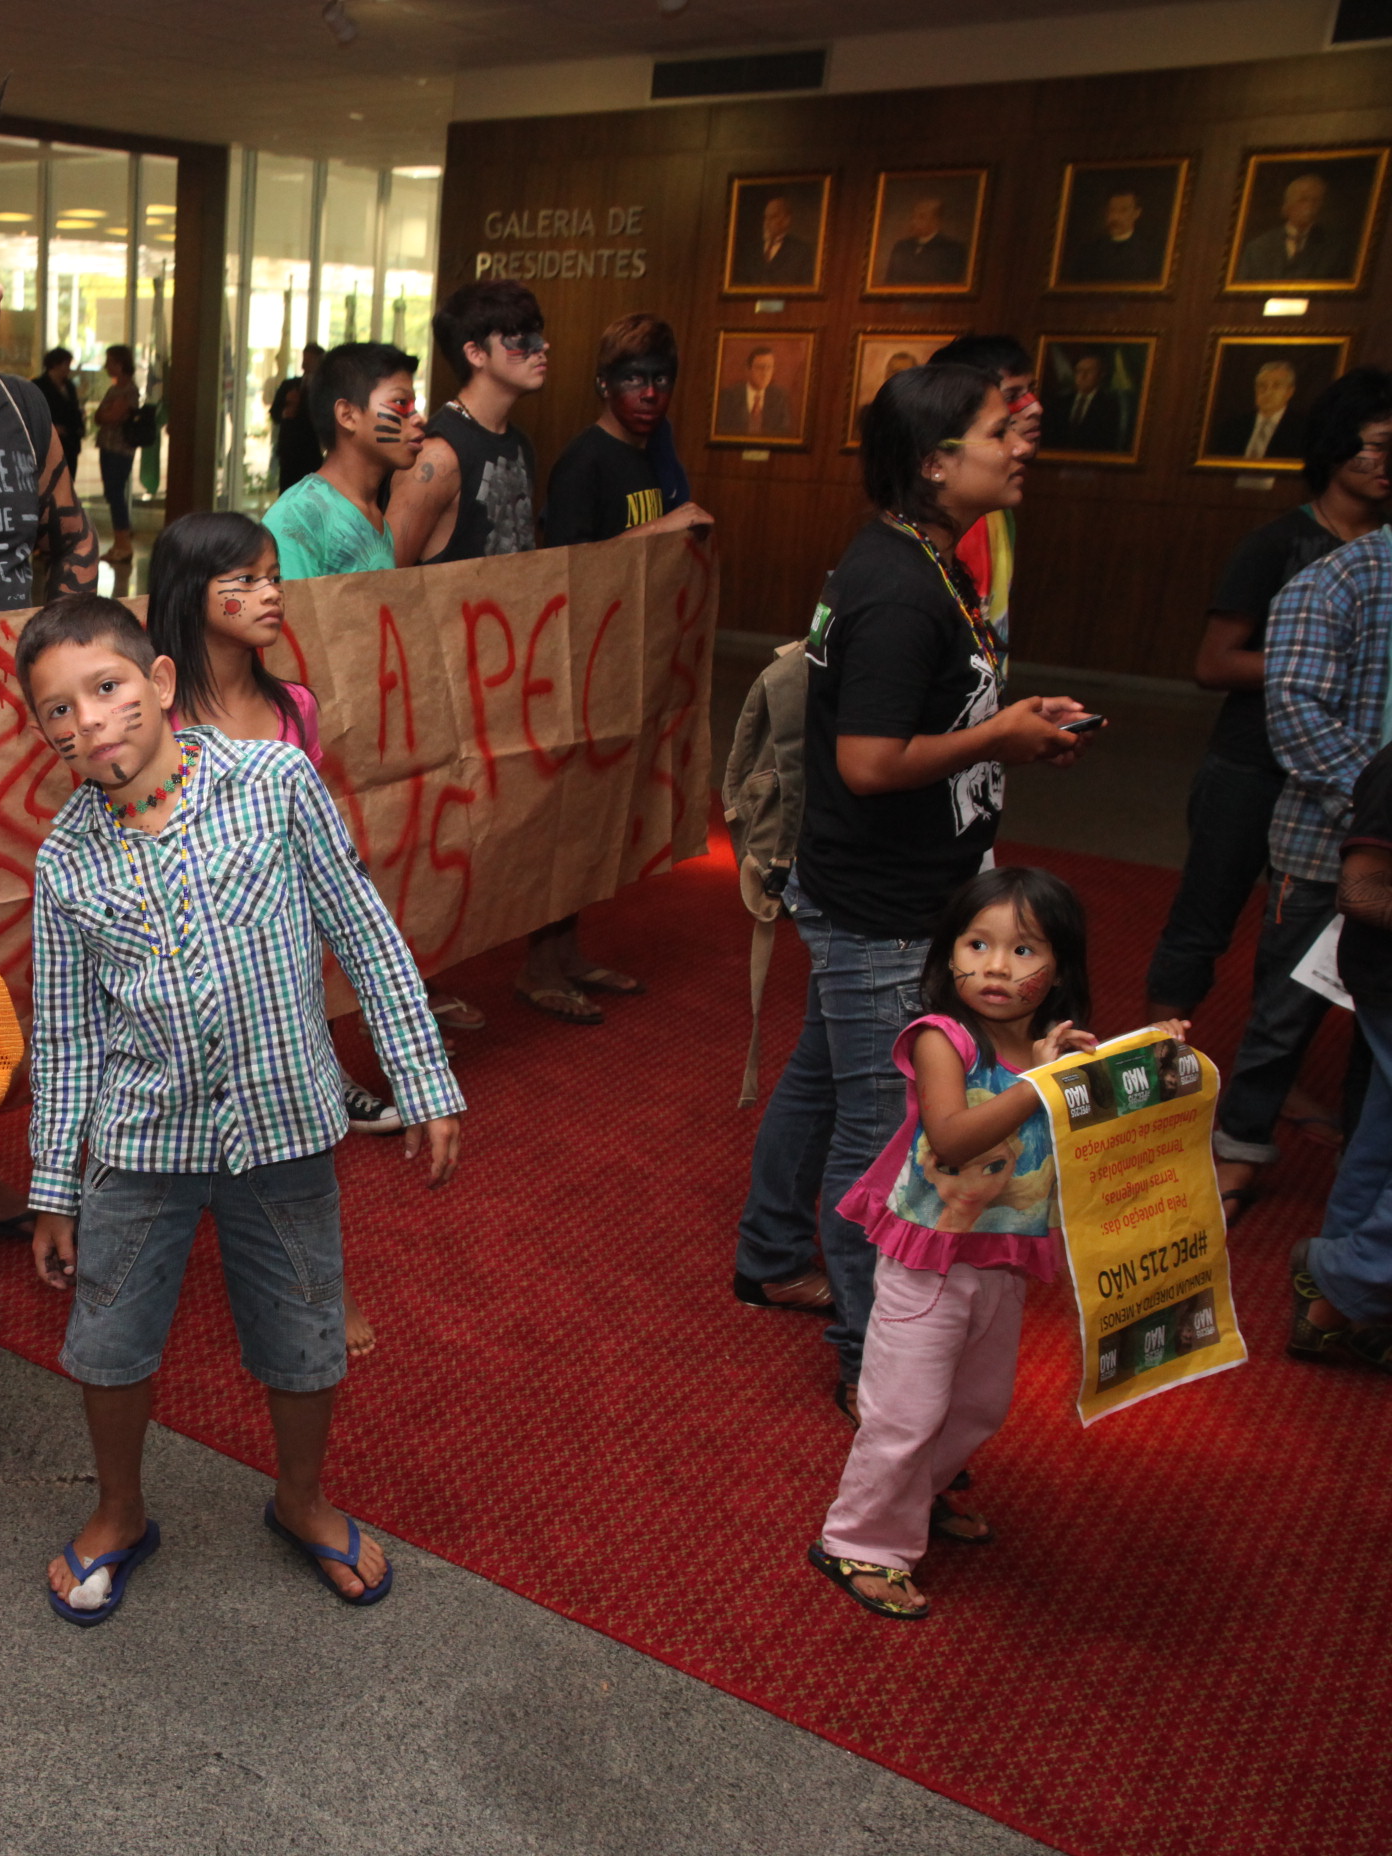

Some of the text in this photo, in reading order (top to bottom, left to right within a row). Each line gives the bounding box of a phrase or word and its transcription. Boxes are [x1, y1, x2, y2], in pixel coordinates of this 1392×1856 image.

[484, 206, 645, 240] GALERIA DE
[474, 249, 648, 281] PRESIDENTES
[461, 594, 633, 798] PEC
[1074, 1109, 1198, 1162] Unidades de Conservação
[1089, 1137, 1185, 1184] Terras Quilombolas e
[1150, 1168, 1179, 1187] Terras
[1122, 1197, 1165, 1230] proteção
[1167, 1193, 1188, 1214] Pela
[1097, 1229, 1208, 1300] #PEC 215 NÃO
[1099, 1268, 1213, 1333] NENHUM DIREITO A MENOS!
